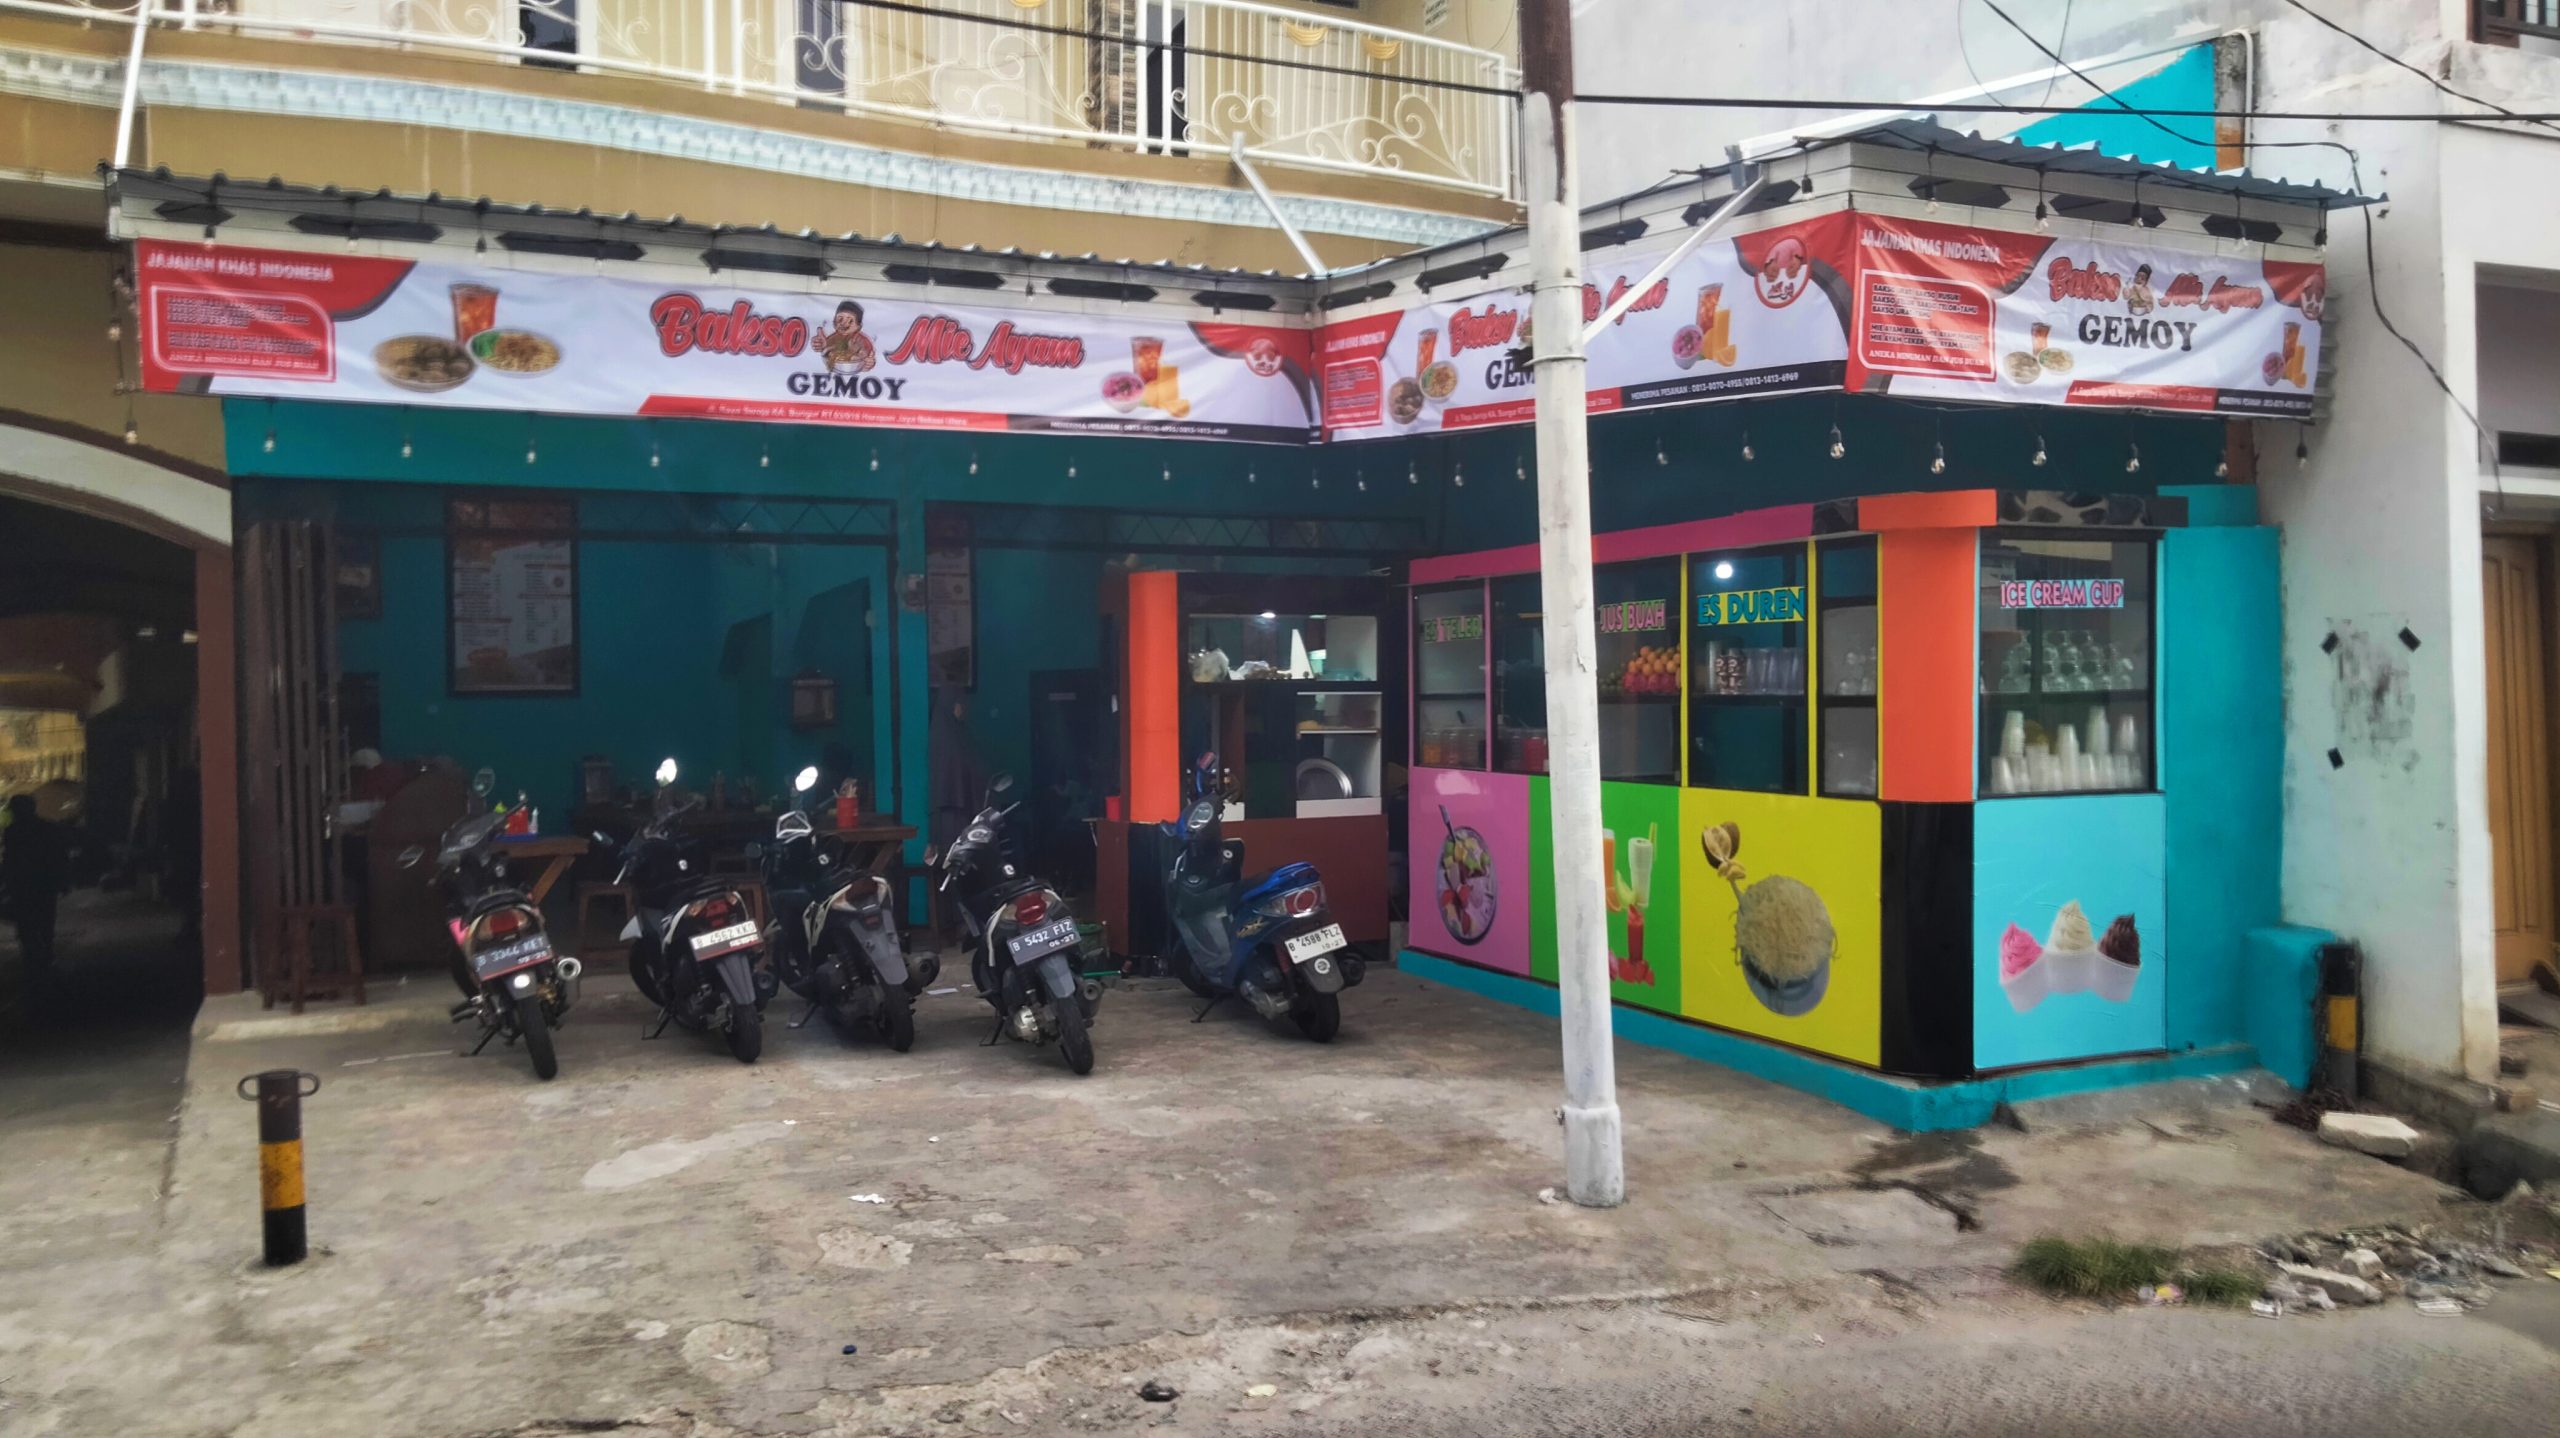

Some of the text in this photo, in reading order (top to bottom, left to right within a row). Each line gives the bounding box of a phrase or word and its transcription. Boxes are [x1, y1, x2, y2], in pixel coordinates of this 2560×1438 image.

[148, 253, 334, 282] JAJANAN KHAS INDONESIA
[2048, 256, 2121, 302] Bakso
[651, 291, 1086, 375] Bakso Mie Ayam
[1449, 304, 1517, 357] Bakso
[2078, 314, 2197, 351] GEMOY
[787, 373, 908, 401] GEMOY
[1697, 588, 1805, 625] ES DUREN
[2000, 580, 2124, 607] ICE CREAM CUP
[1424, 619, 1436, 642] ES
[1600, 600, 1665, 632] JUS BUAH
[1012, 942, 1020, 952] B
[1025, 930, 1049, 947] 5432
[1288, 942, 1296, 952] B
[1324, 927, 1341, 939] FLZ
